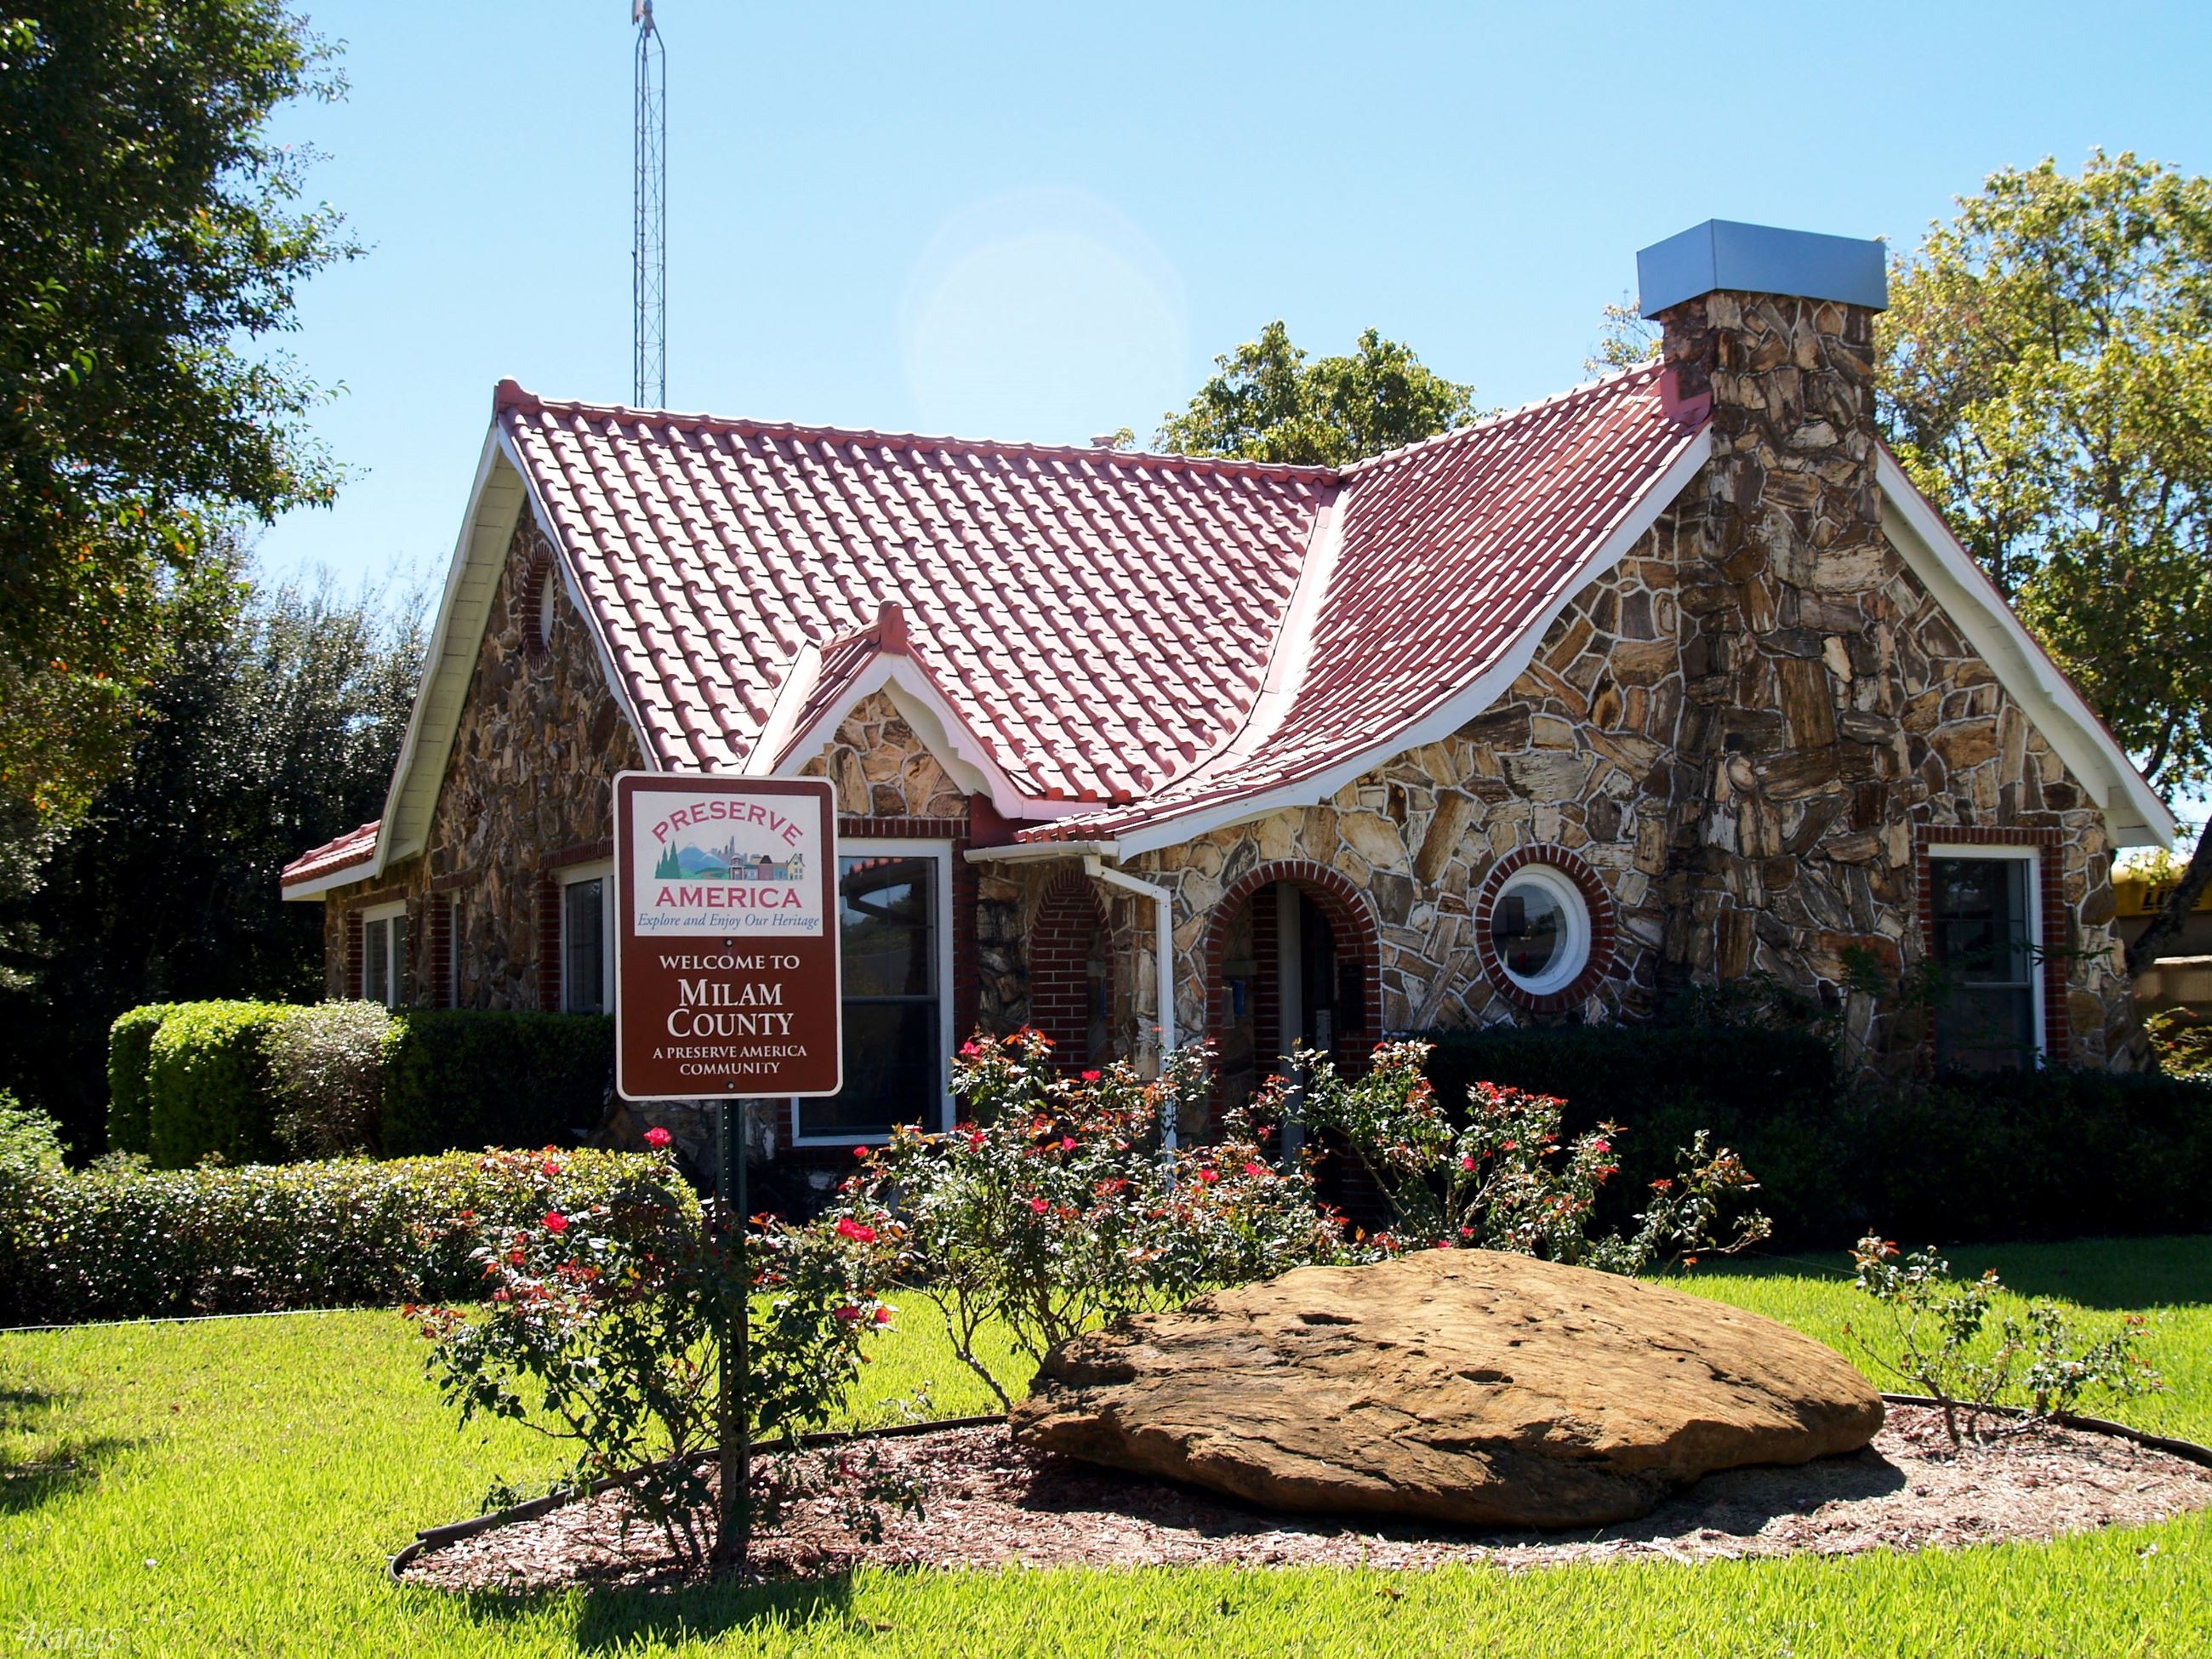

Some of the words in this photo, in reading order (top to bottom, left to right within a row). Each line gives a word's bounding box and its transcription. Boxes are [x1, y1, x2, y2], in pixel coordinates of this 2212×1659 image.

[652, 801, 803, 847] PRESERVE
[655, 887, 802, 909] AMERICA
[638, 913, 681, 930] Explore
[683, 914, 706, 926] and
[710, 914, 741, 930] Enjoy
[744, 914, 768, 926] Our
[772, 914, 819, 930] Heritage
[659, 955, 765, 970] WELCOME
[769, 955, 801, 970] TO
[653, 1047, 664, 1059] A
[667, 1046, 737, 1058] PRESERVE
[739, 1045, 807, 1058] AMERICA
[680, 1062, 780, 1075] COMMUNITY
